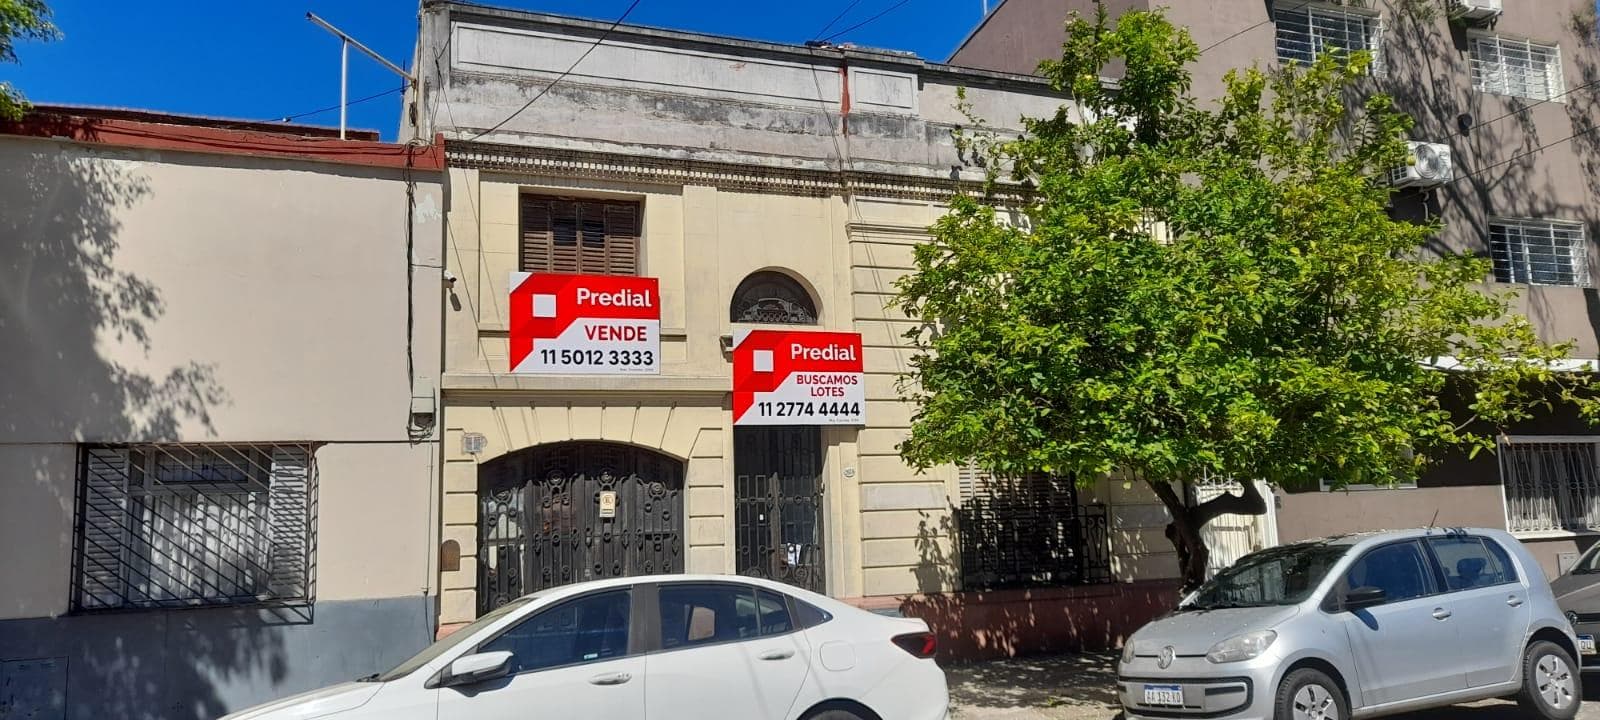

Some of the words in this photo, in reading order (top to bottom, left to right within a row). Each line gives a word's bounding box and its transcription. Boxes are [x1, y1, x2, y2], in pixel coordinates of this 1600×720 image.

[577, 287, 652, 307] Predial
[584, 325, 647, 341] VENDE
[540, 349, 556, 365] 11
[561, 349, 603, 365] 5012
[609, 350, 654, 366] 3333
[791, 343, 856, 361] Predial
[796, 374, 858, 385] BUSCAMOS
[811, 386, 845, 397] LOTES
[758, 402, 772, 416] 11
[776, 402, 814, 416] 2774
[819, 402, 860, 416] 4444
